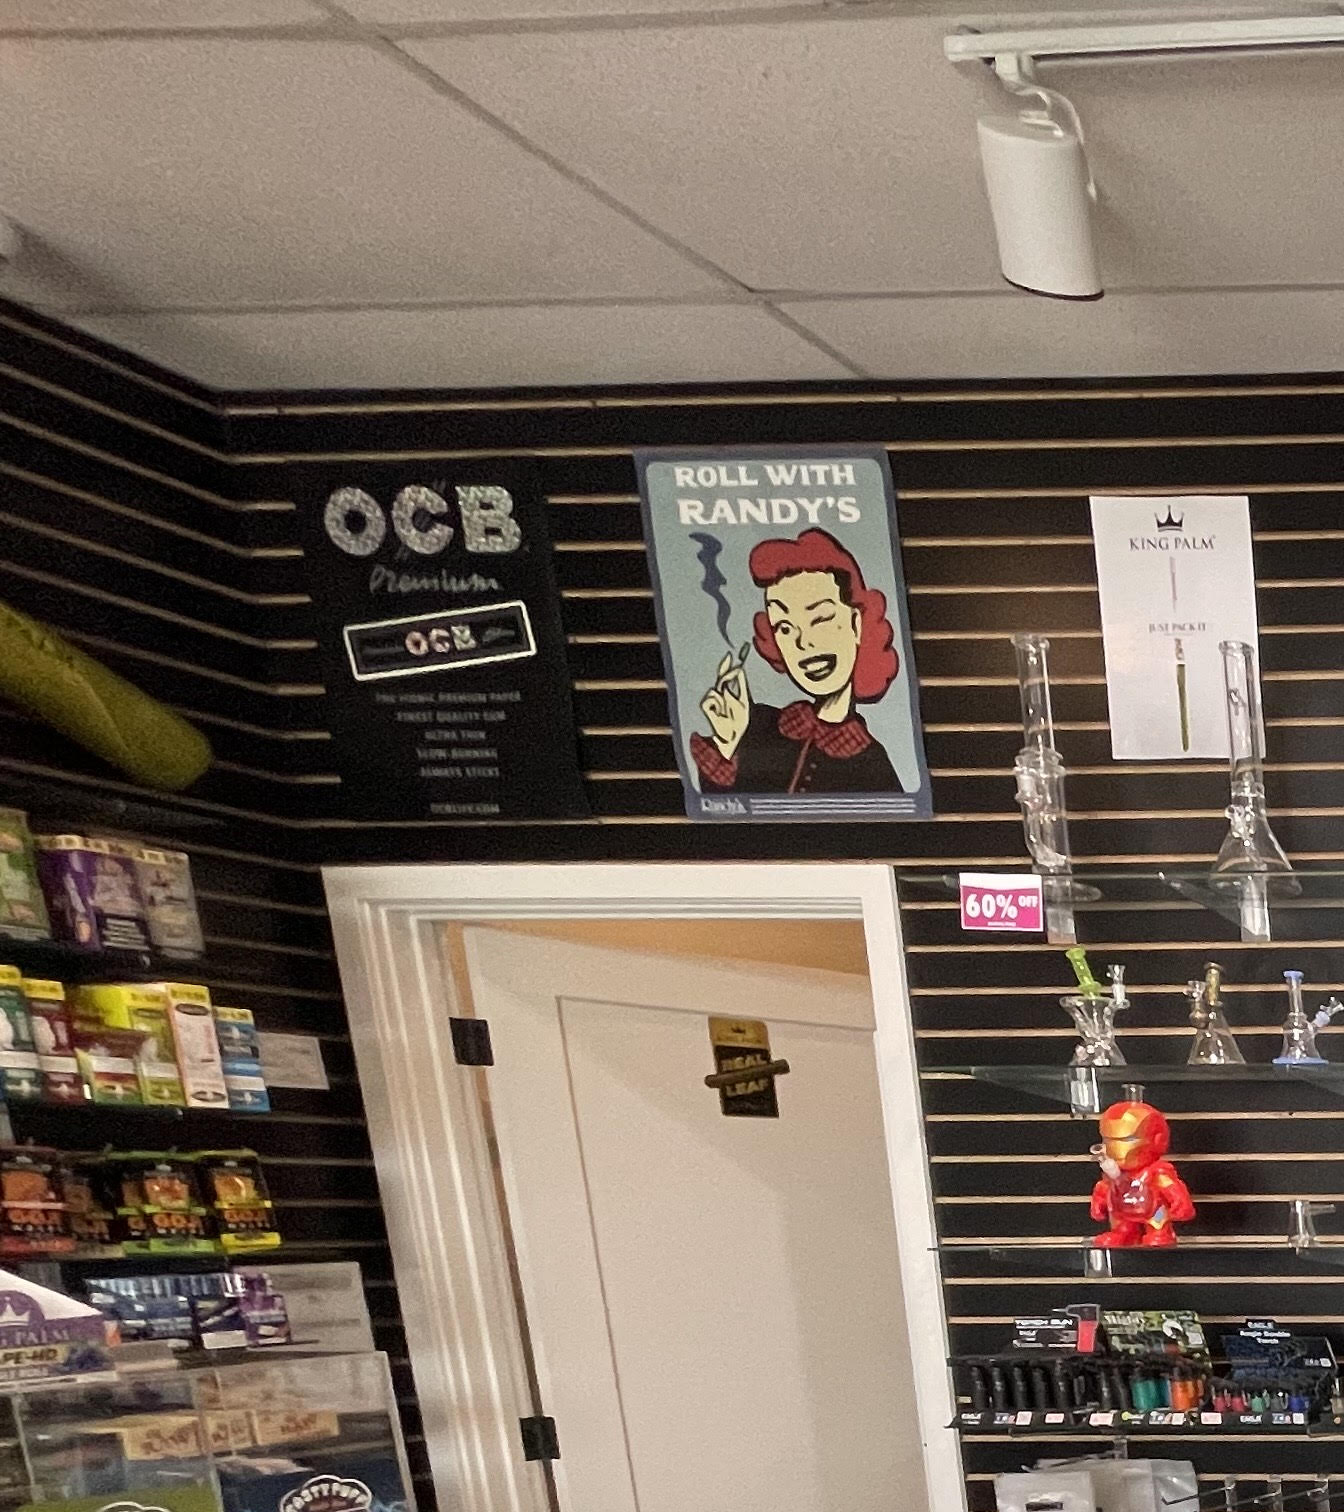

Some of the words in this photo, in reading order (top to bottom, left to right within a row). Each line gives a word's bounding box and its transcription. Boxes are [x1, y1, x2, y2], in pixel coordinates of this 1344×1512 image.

[674, 466, 758, 488] ROLL
[764, 464, 856, 486] WITH
[323, 485, 523, 556] OCB
[677, 496, 861, 524] RANDY'S
[1130, 537, 1169, 551] KING
[1174, 536, 1214, 551] PALM
[966, 893, 1018, 919] 60%
